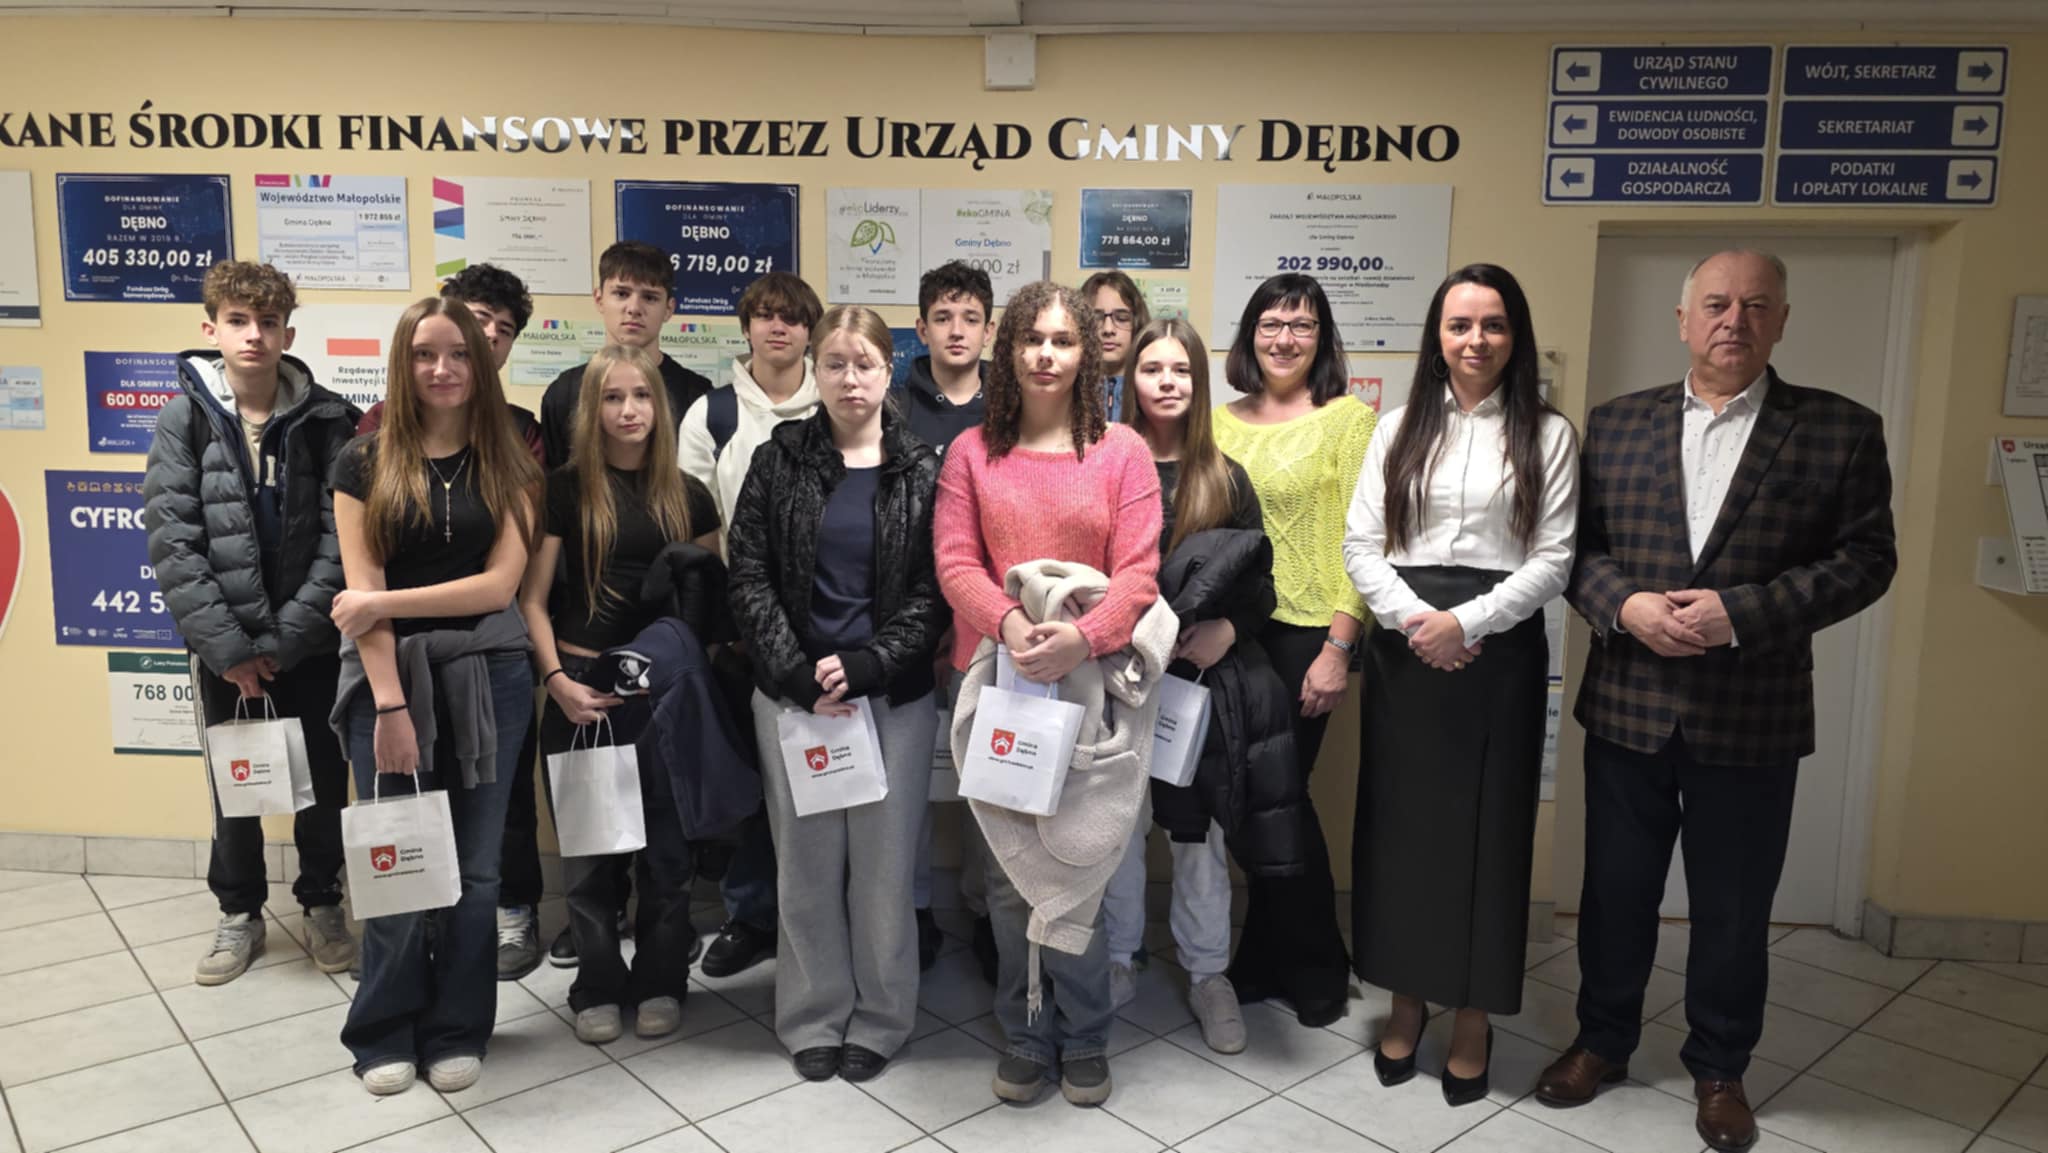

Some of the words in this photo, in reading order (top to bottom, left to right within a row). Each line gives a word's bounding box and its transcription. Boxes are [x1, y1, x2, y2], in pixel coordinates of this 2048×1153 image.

[1633, 55, 1685, 72] URZĄD
[1688, 56, 1738, 70] STANU
[1805, 62, 1850, 80] WÓJT,
[1853, 64, 1937, 80] SEKRETARZ
[1638, 76, 1729, 90] CYWILNEGO
[1608, 110, 1684, 123] EWIDENCJA
[1687, 106, 1758, 124] LUDNOŚCI,
[129, 100, 321, 150] ŚRODKI
[338, 114, 648, 155] FINANSOWE
[663, 119, 829, 158] PRZEZ
[1617, 127, 1680, 140] DOWODY
[1682, 127, 1747, 141] OSOBISTE
[1817, 119, 1915, 134] SEKRETARIAT
[1627, 158, 1729, 176] DZIAŁALNOŚĆ
[1830, 162, 1896, 176] PODATKI
[1621, 181, 1732, 196] GOSPODARCZA
[1792, 182, 1798, 196] I
[1801, 182, 1859, 196] OPŁATY
[1861, 182, 1929, 197] LOKALNE
[104, 195, 180, 203] DOFINANSOWANIE
[260, 192, 334, 204] Województwo
[337, 193, 401, 206] Małopolskie
[665, 204, 745, 213] DOFINANSOWANIE
[120, 216, 168, 232] DĘBNO
[106, 234, 136, 242] RAZEM
[140, 234, 148, 242] W
[681, 225, 730, 242] DĘBNO
[1101, 235, 1120, 245] 778
[1161, 236, 1171, 246] zł
[955, 238, 981, 248] Gminy
[983, 238, 1012, 249] Dębno
[82, 248, 119, 266] 405
[124, 249, 191, 269] 330,00
[195, 250, 213, 267] zł
[686, 254, 750, 275] 719,00
[754, 255, 773, 273] zł
[1276, 256, 1312, 271] 202
[1316, 256, 1384, 274] 990,00
[1007, 259, 1021, 274] zł
[523, 331, 577, 341] MAŁOPOLSKA
[660, 335, 718, 345] MAŁOPOLSKA
[115, 358, 175, 366] DOFINANSOW
[337, 365, 379, 376] Rządowy
[120, 380, 136, 388] DLA
[137, 380, 164, 388] GMINY
[331, 376, 381, 387] Inwestycji
[106, 392, 136, 407] 600
[139, 393, 169, 407] 000
[91, 589, 141, 614] 442
[149, 591, 171, 615] 5
[132, 684, 167, 701] 768
[172, 685, 194, 701] 00
